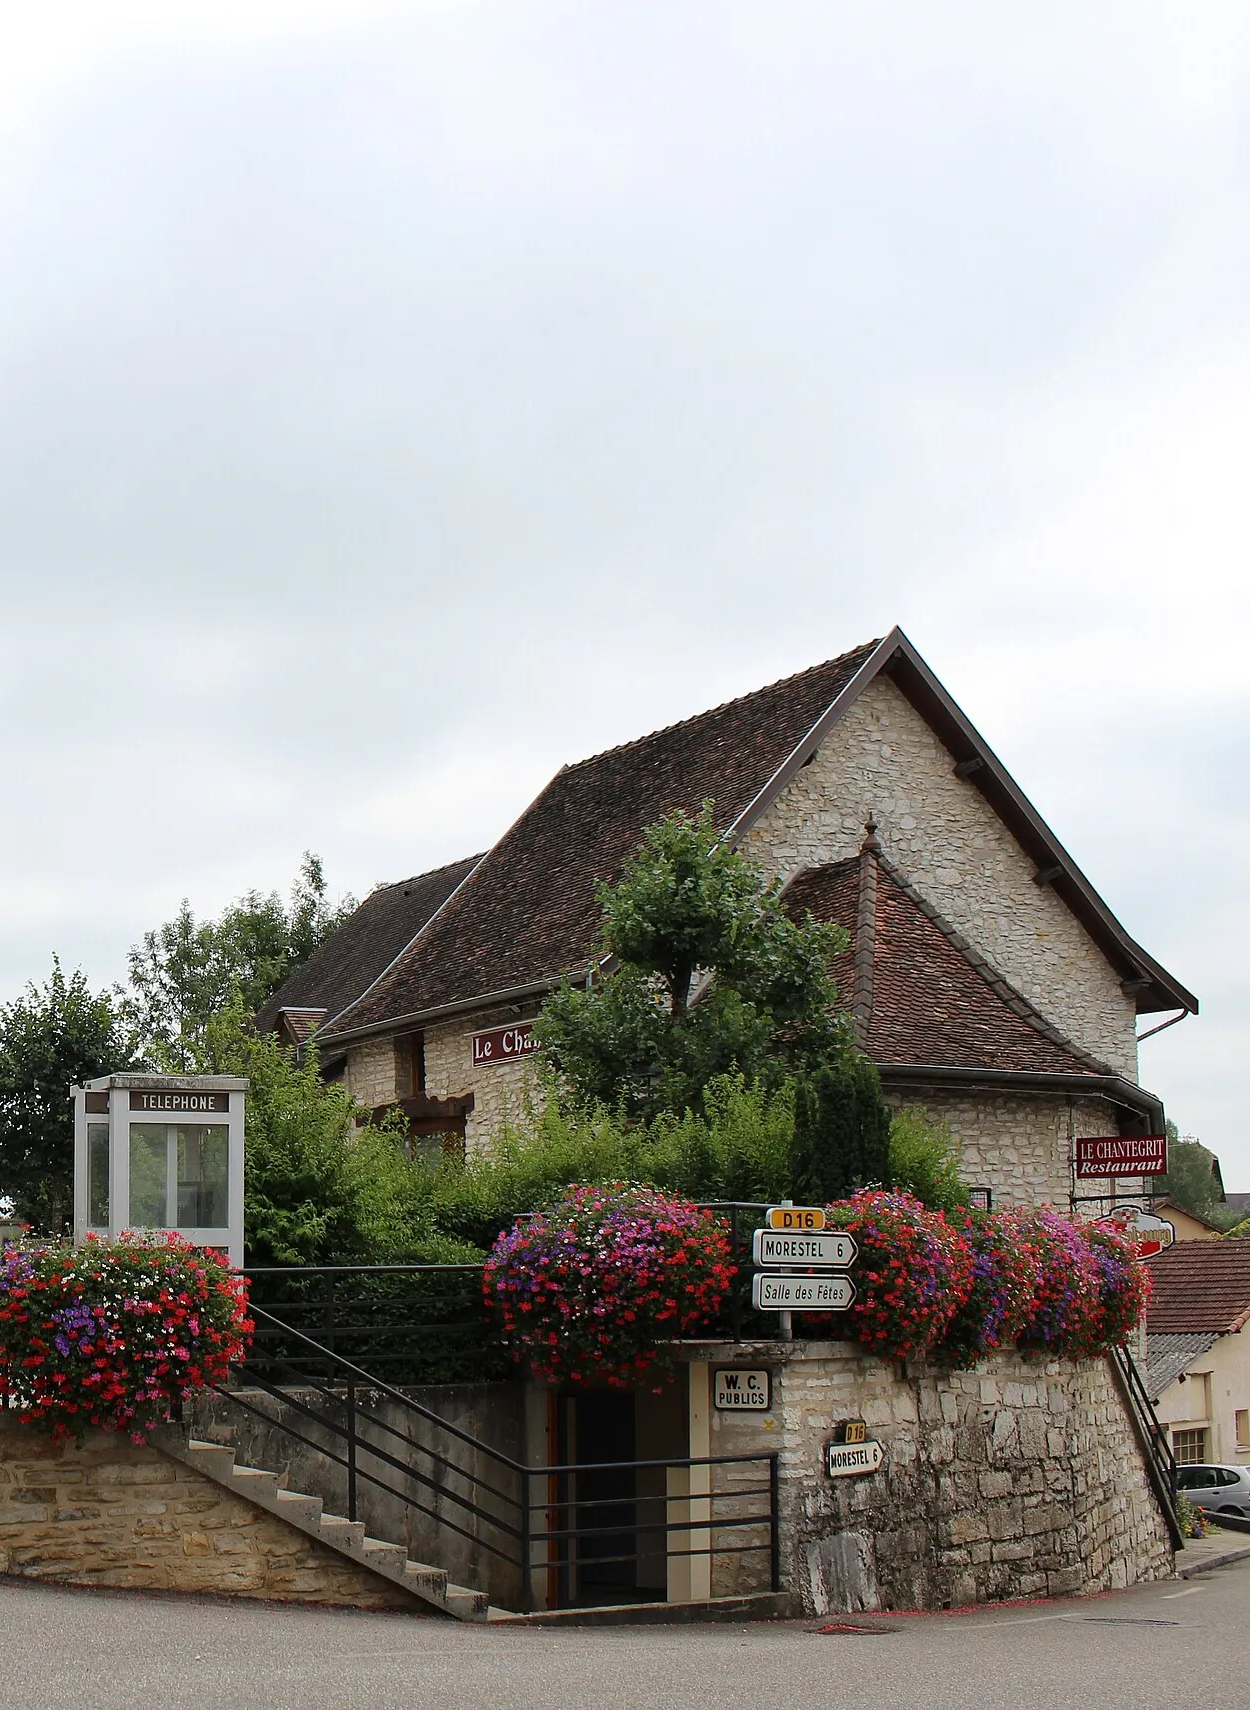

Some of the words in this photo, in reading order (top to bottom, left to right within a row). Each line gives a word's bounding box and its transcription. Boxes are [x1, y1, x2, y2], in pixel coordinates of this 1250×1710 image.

[474, 1037, 492, 1059] Le
[141, 1094, 215, 1110] TELEPHONE
[1081, 1143, 1094, 1159] LE
[1096, 1139, 1164, 1159] CHANTEGRIT
[1080, 1159, 1163, 1174] Restaurant
[765, 1240, 824, 1257] MORESTEL
[837, 1243, 844, 1258] 6
[764, 1284, 791, 1300] Salle
[795, 1284, 813, 1300] des
[817, 1285, 844, 1300] Fêtes
[719, 1392, 765, 1405] PUBLICS
[830, 1449, 869, 1468] MORESTEL
[872, 1448, 878, 1463] 6
